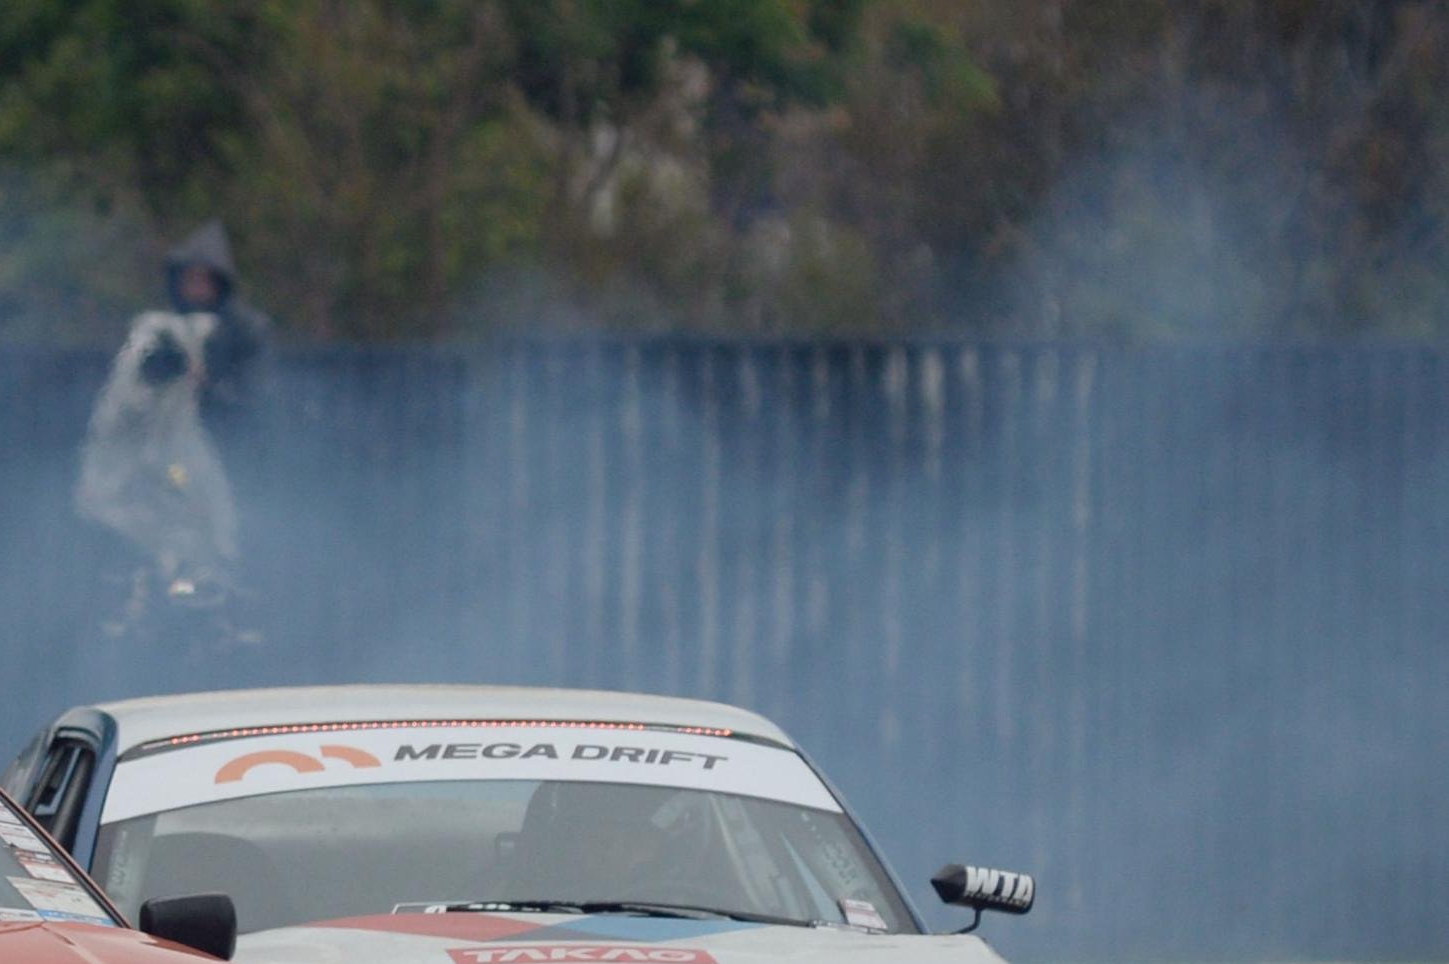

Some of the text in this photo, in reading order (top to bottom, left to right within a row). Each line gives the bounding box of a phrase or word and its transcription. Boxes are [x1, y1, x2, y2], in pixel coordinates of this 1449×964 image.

[393, 742, 728, 771] MEGA DRIFT
[463, 947, 697, 963] TAKAO
